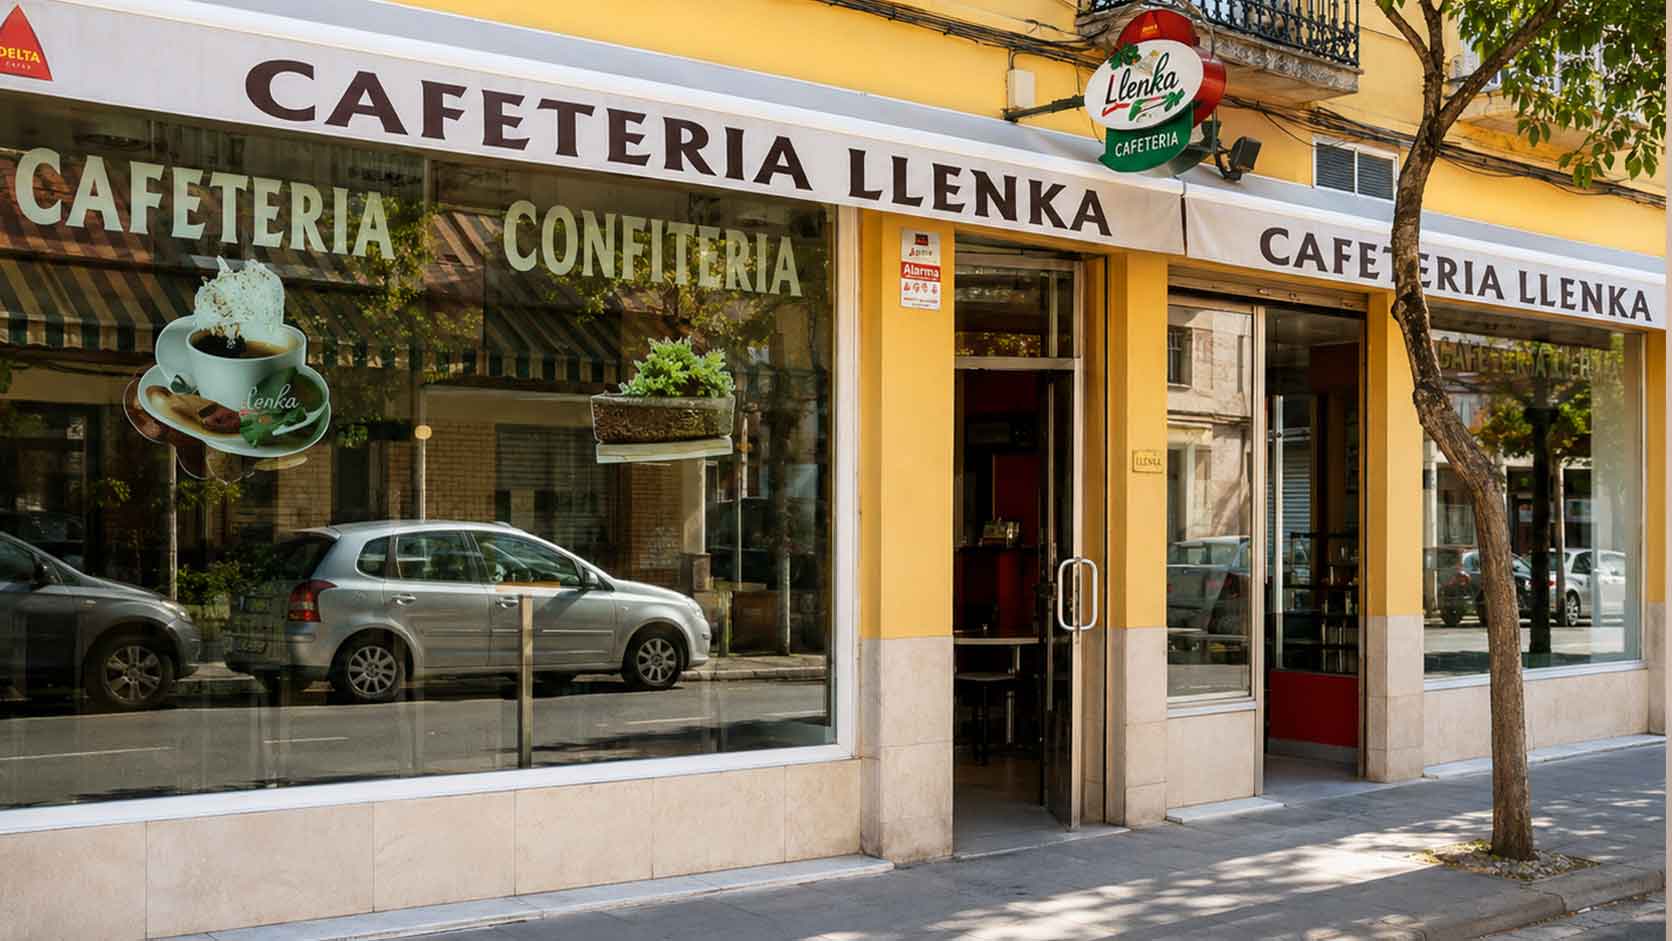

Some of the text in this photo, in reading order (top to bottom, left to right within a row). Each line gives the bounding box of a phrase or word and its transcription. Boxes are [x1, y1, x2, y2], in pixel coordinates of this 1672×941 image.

[0, 46, 40, 63] DELTA
[1105, 52, 1179, 104] Llenka
[245, 59, 1112, 236] CAFETERIA LLENKA
[1115, 131, 1179, 157] CAFETERIA
[15, 147, 395, 259] CAFETERIA
[503, 200, 802, 297] CONFITERIA
[903, 263, 940, 278] Alarma
[1518, 268, 1653, 322] LLENKA
